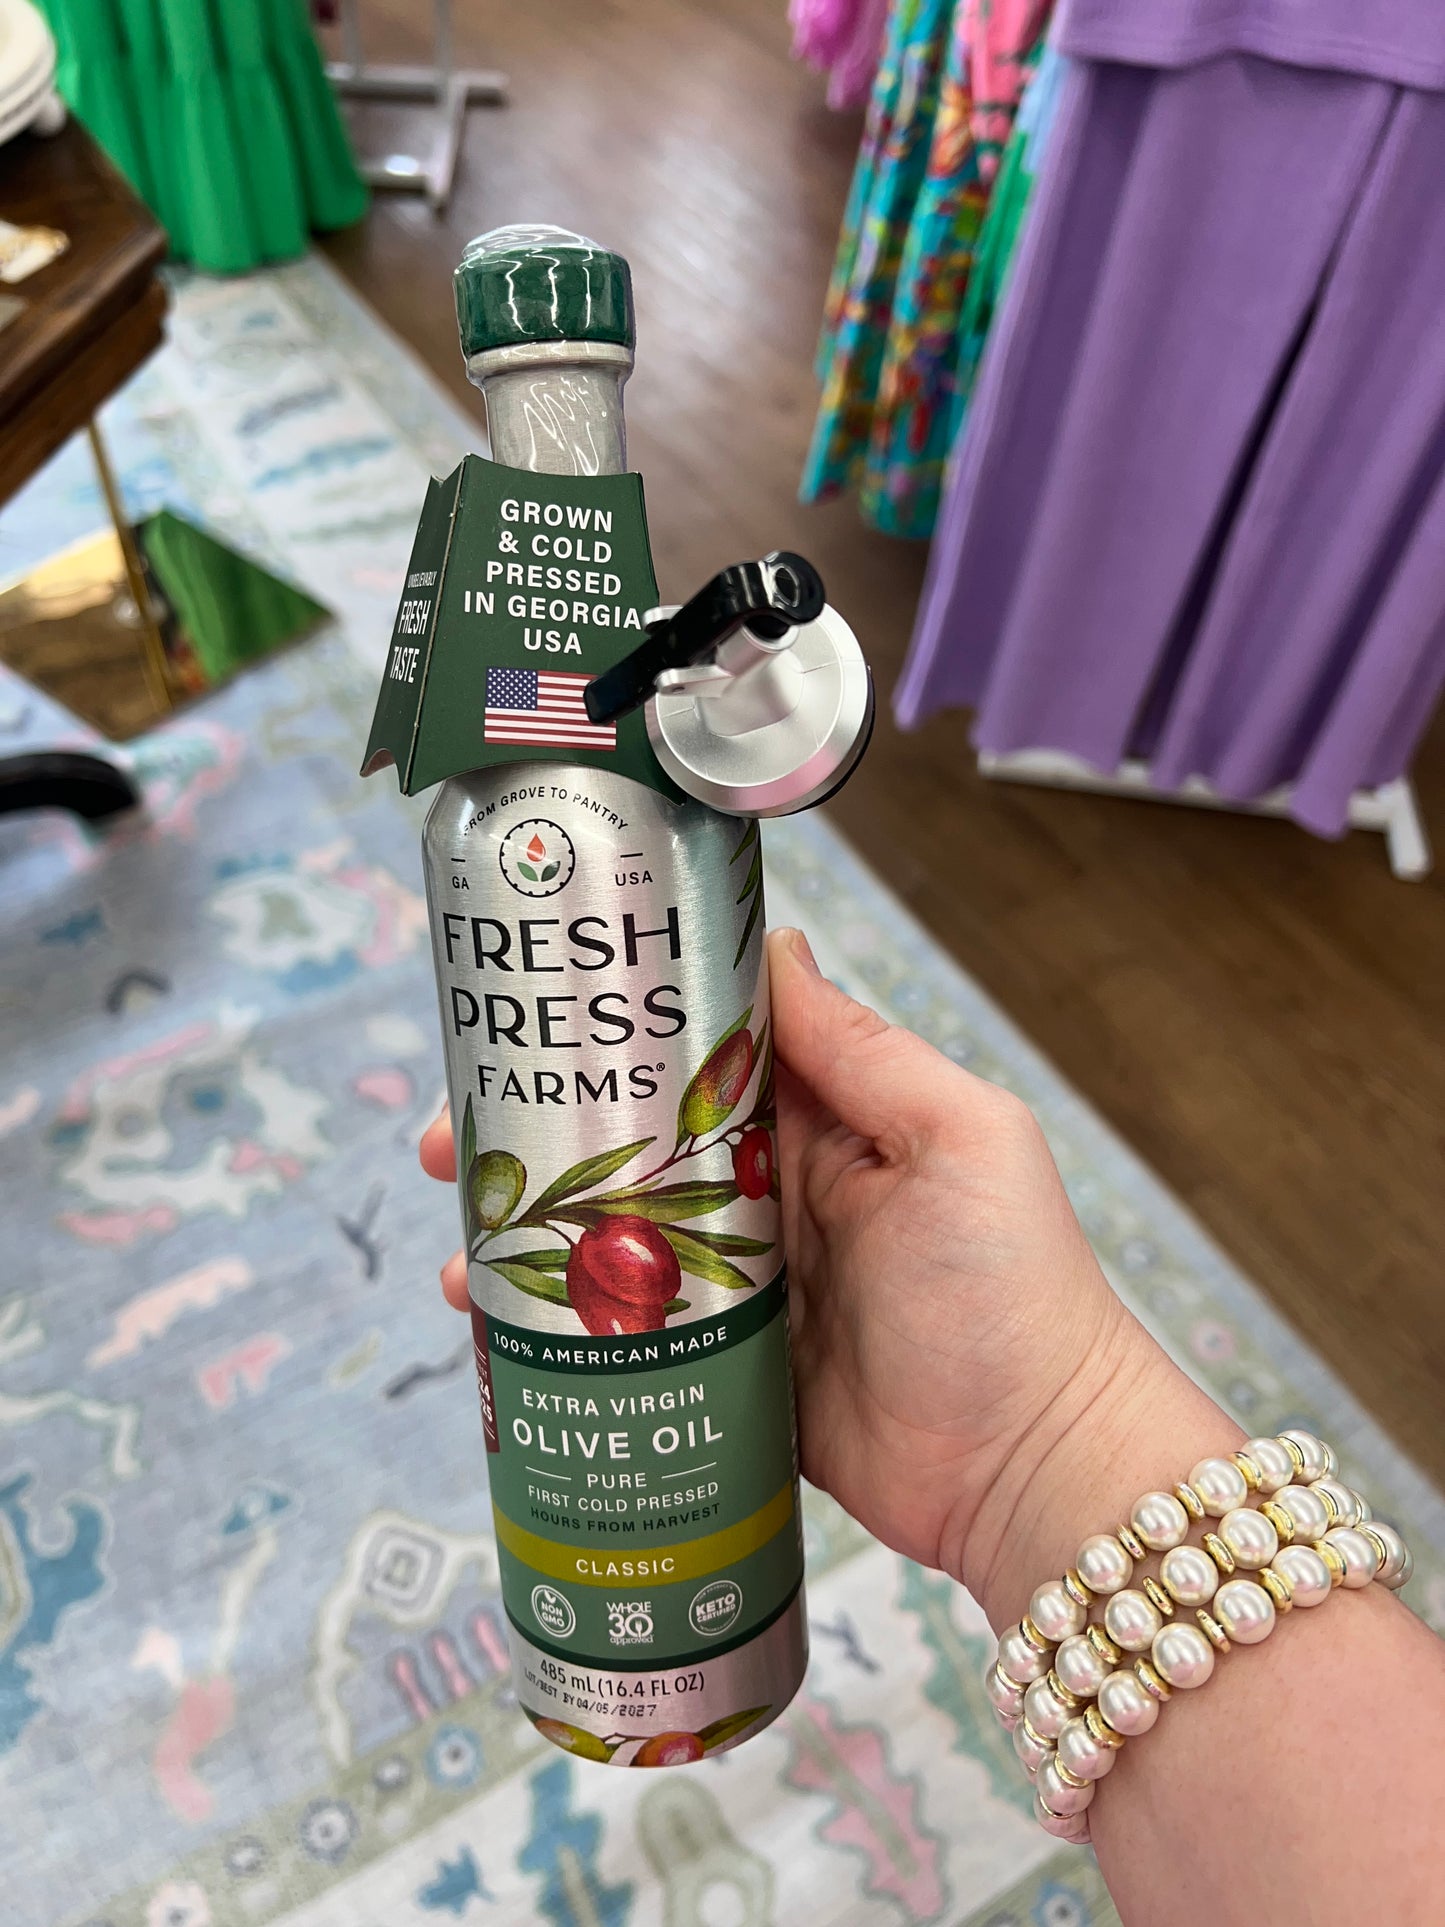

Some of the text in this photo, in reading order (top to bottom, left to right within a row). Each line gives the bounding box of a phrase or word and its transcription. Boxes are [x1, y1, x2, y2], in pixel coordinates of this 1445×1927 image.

[500, 499, 612, 533] GROWN
[498, 530, 612, 563] & COLD
[486, 561, 621, 596] PRESSED
[398, 600, 431, 634] FRESH
[464, 591, 641, 630] IN GEORGIA
[523, 628, 582, 655] USA
[390, 646, 420, 683] TASTE
[500, 786, 545, 807] GROVE
[550, 787, 568, 800] TO
[572, 793, 629, 831] PANTRY
[452, 876, 470, 890] GA
[615, 870, 654, 887] USA
[443, 906, 682, 972] FRESH
[451, 985, 687, 1048] PRESS
[494, 1326, 727, 1365] 100% AMERICAN MADE
[522, 1383, 705, 1416] EXTRA VIRGIN
[513, 1416, 723, 1459] OLIVE OIL
[528, 1481, 719, 1512] FIRST COLD PRESSED
[587, 1472, 648, 1489] PURE
[530, 1502, 721, 1533] HOURS FROM HARVEST
[575, 1557, 676, 1576] CLASSIC
[541, 1601, 563, 1617] NON
[541, 1611, 565, 1628] GMO
[606, 1601, 652, 1614] WHOLE
[695, 1593, 736, 1617] KETO
[697, 1603, 736, 1623] CERTIFIED
[608, 1613, 654, 1637] 30
[609, 1634, 654, 1646] approved
[524, 1666, 558, 1698] LOT/BEST
[563, 1691, 576, 1706] BY
[540, 1659, 705, 1699] 485 mL (16.4 FL OZ)
